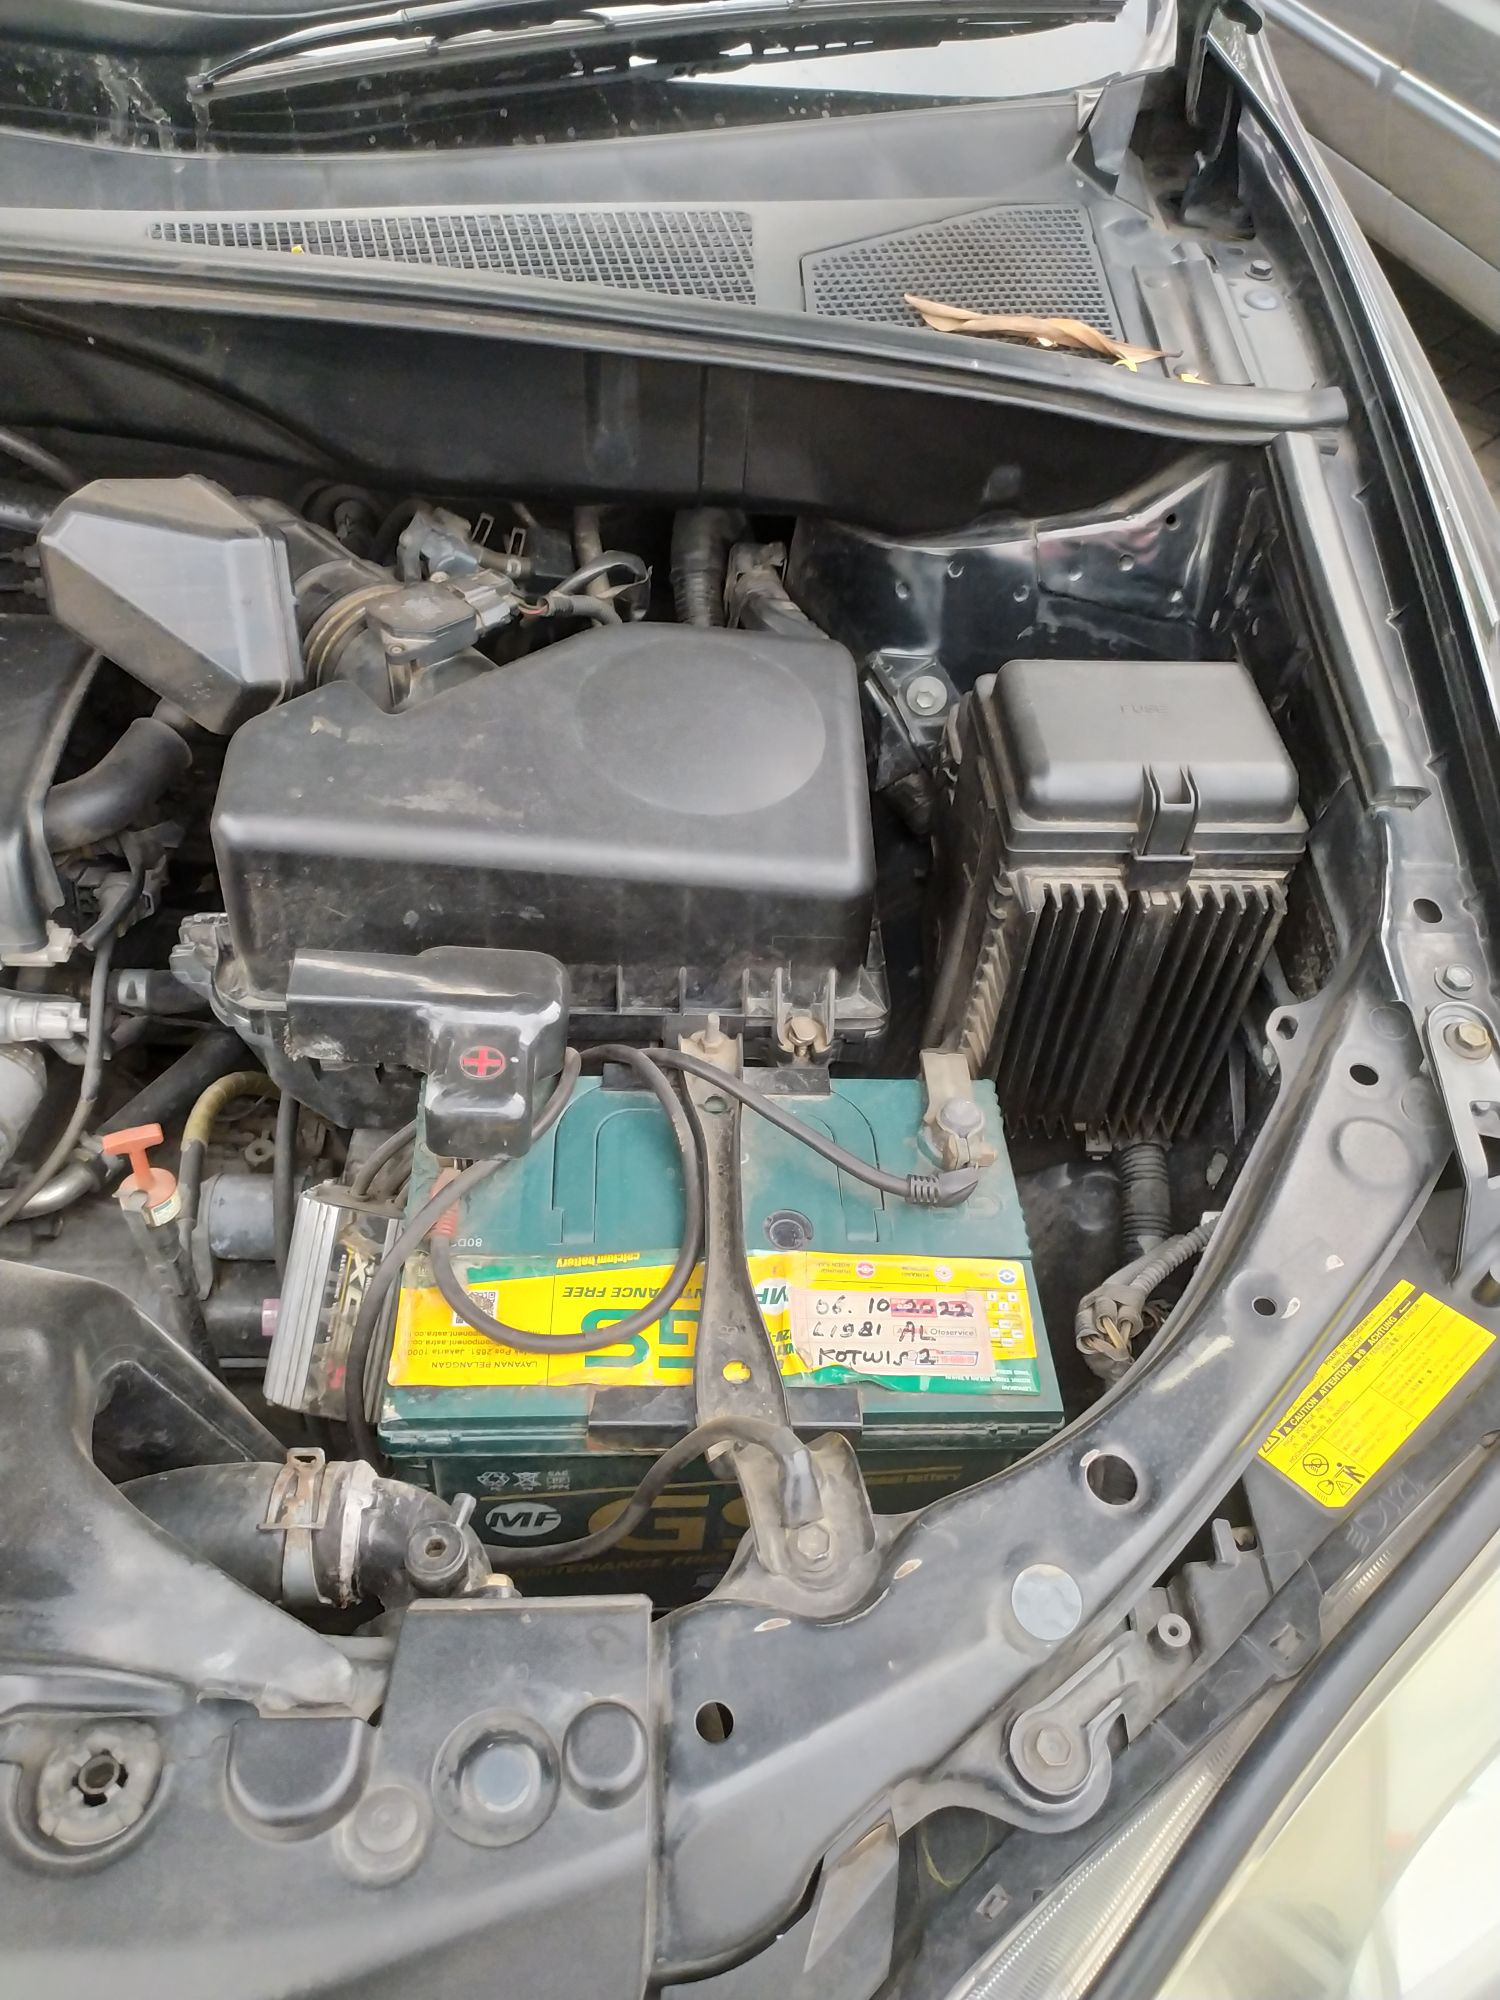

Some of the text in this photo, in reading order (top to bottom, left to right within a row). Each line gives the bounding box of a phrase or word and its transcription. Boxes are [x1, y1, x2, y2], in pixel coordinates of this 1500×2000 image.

[1119, 702, 1169, 714] FUSE
[562, 1286, 607, 1298] FREE
[930, 1327, 975, 1337] Otoservice
[1289, 1396, 1319, 1426] CAUTION
[1318, 1361, 1353, 1396] ATTENTION
[1367, 1314, 1398, 1346] ACHTUNG
[487, 1511, 560, 1528] MF
